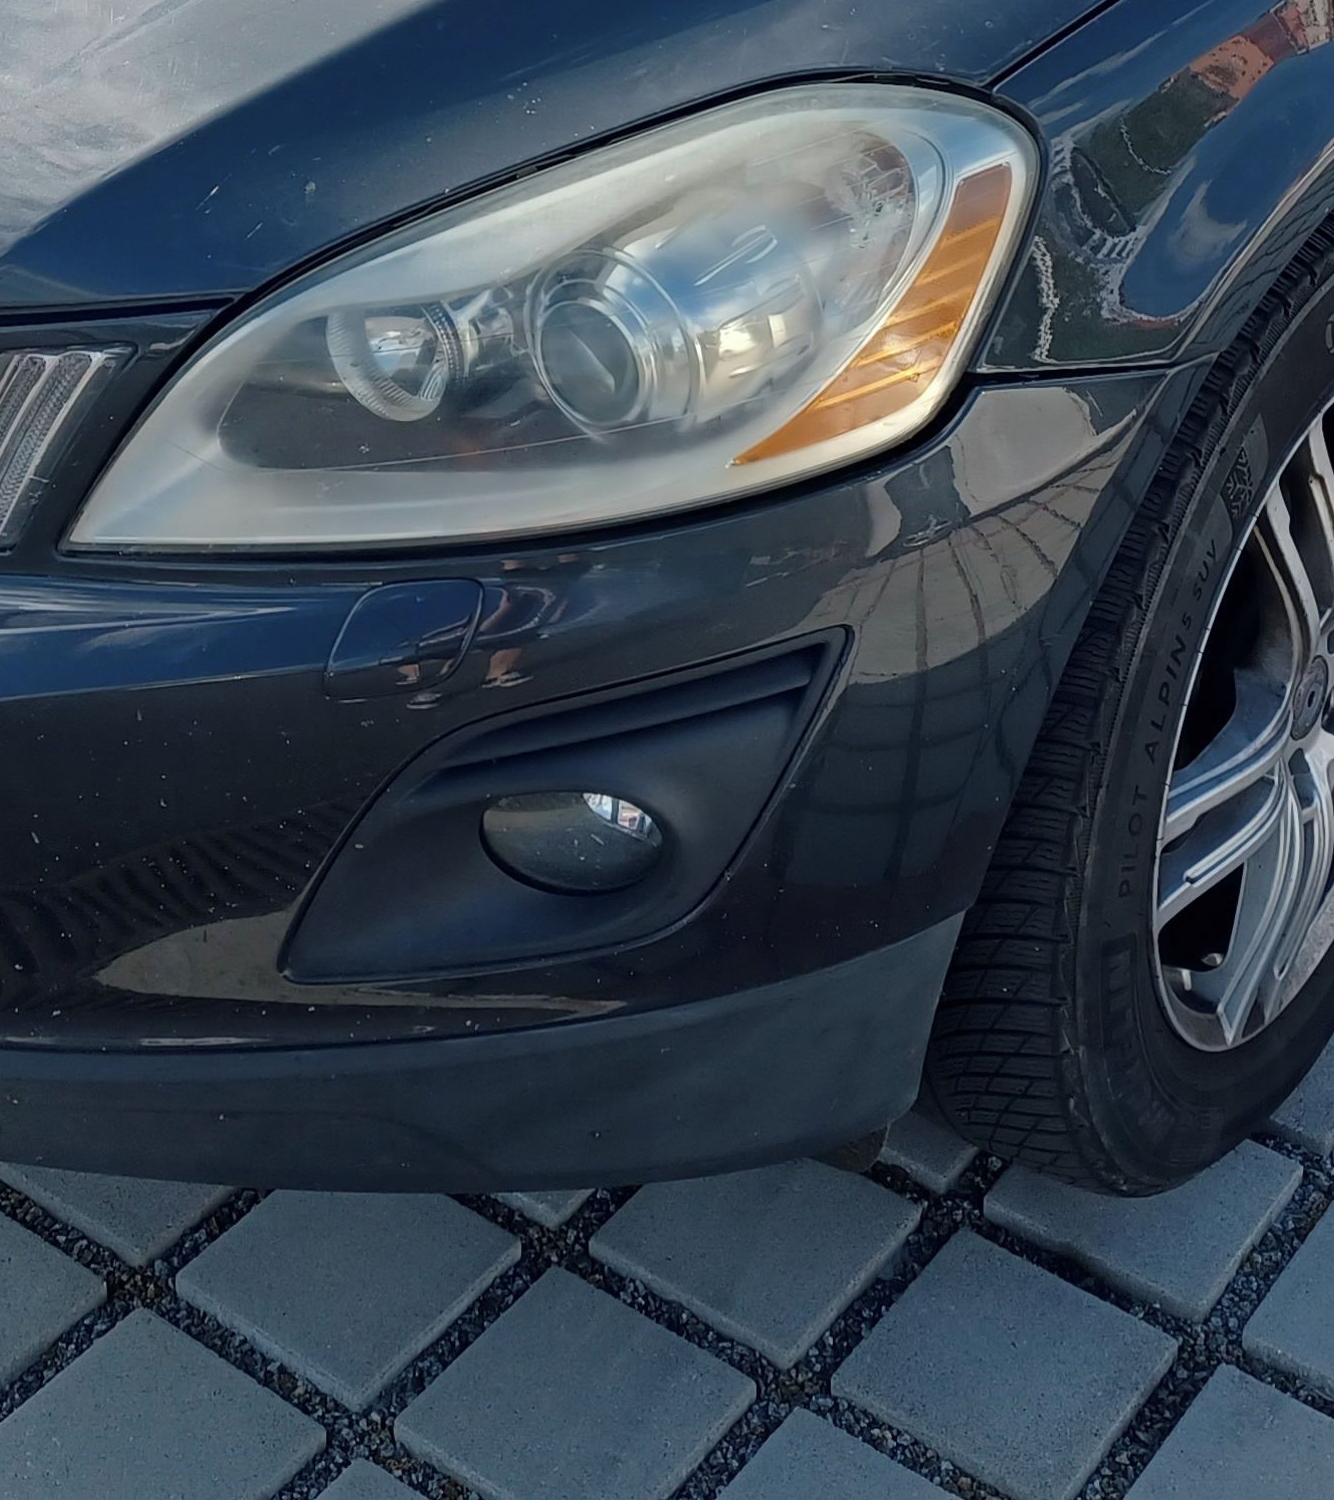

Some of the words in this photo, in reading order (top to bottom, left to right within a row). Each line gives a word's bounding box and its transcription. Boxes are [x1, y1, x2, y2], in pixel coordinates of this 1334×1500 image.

[1118, 784, 1147, 897] PILOT
[1145, 633, 1187, 765] ALPIN
[1192, 539, 1217, 602] SUV
